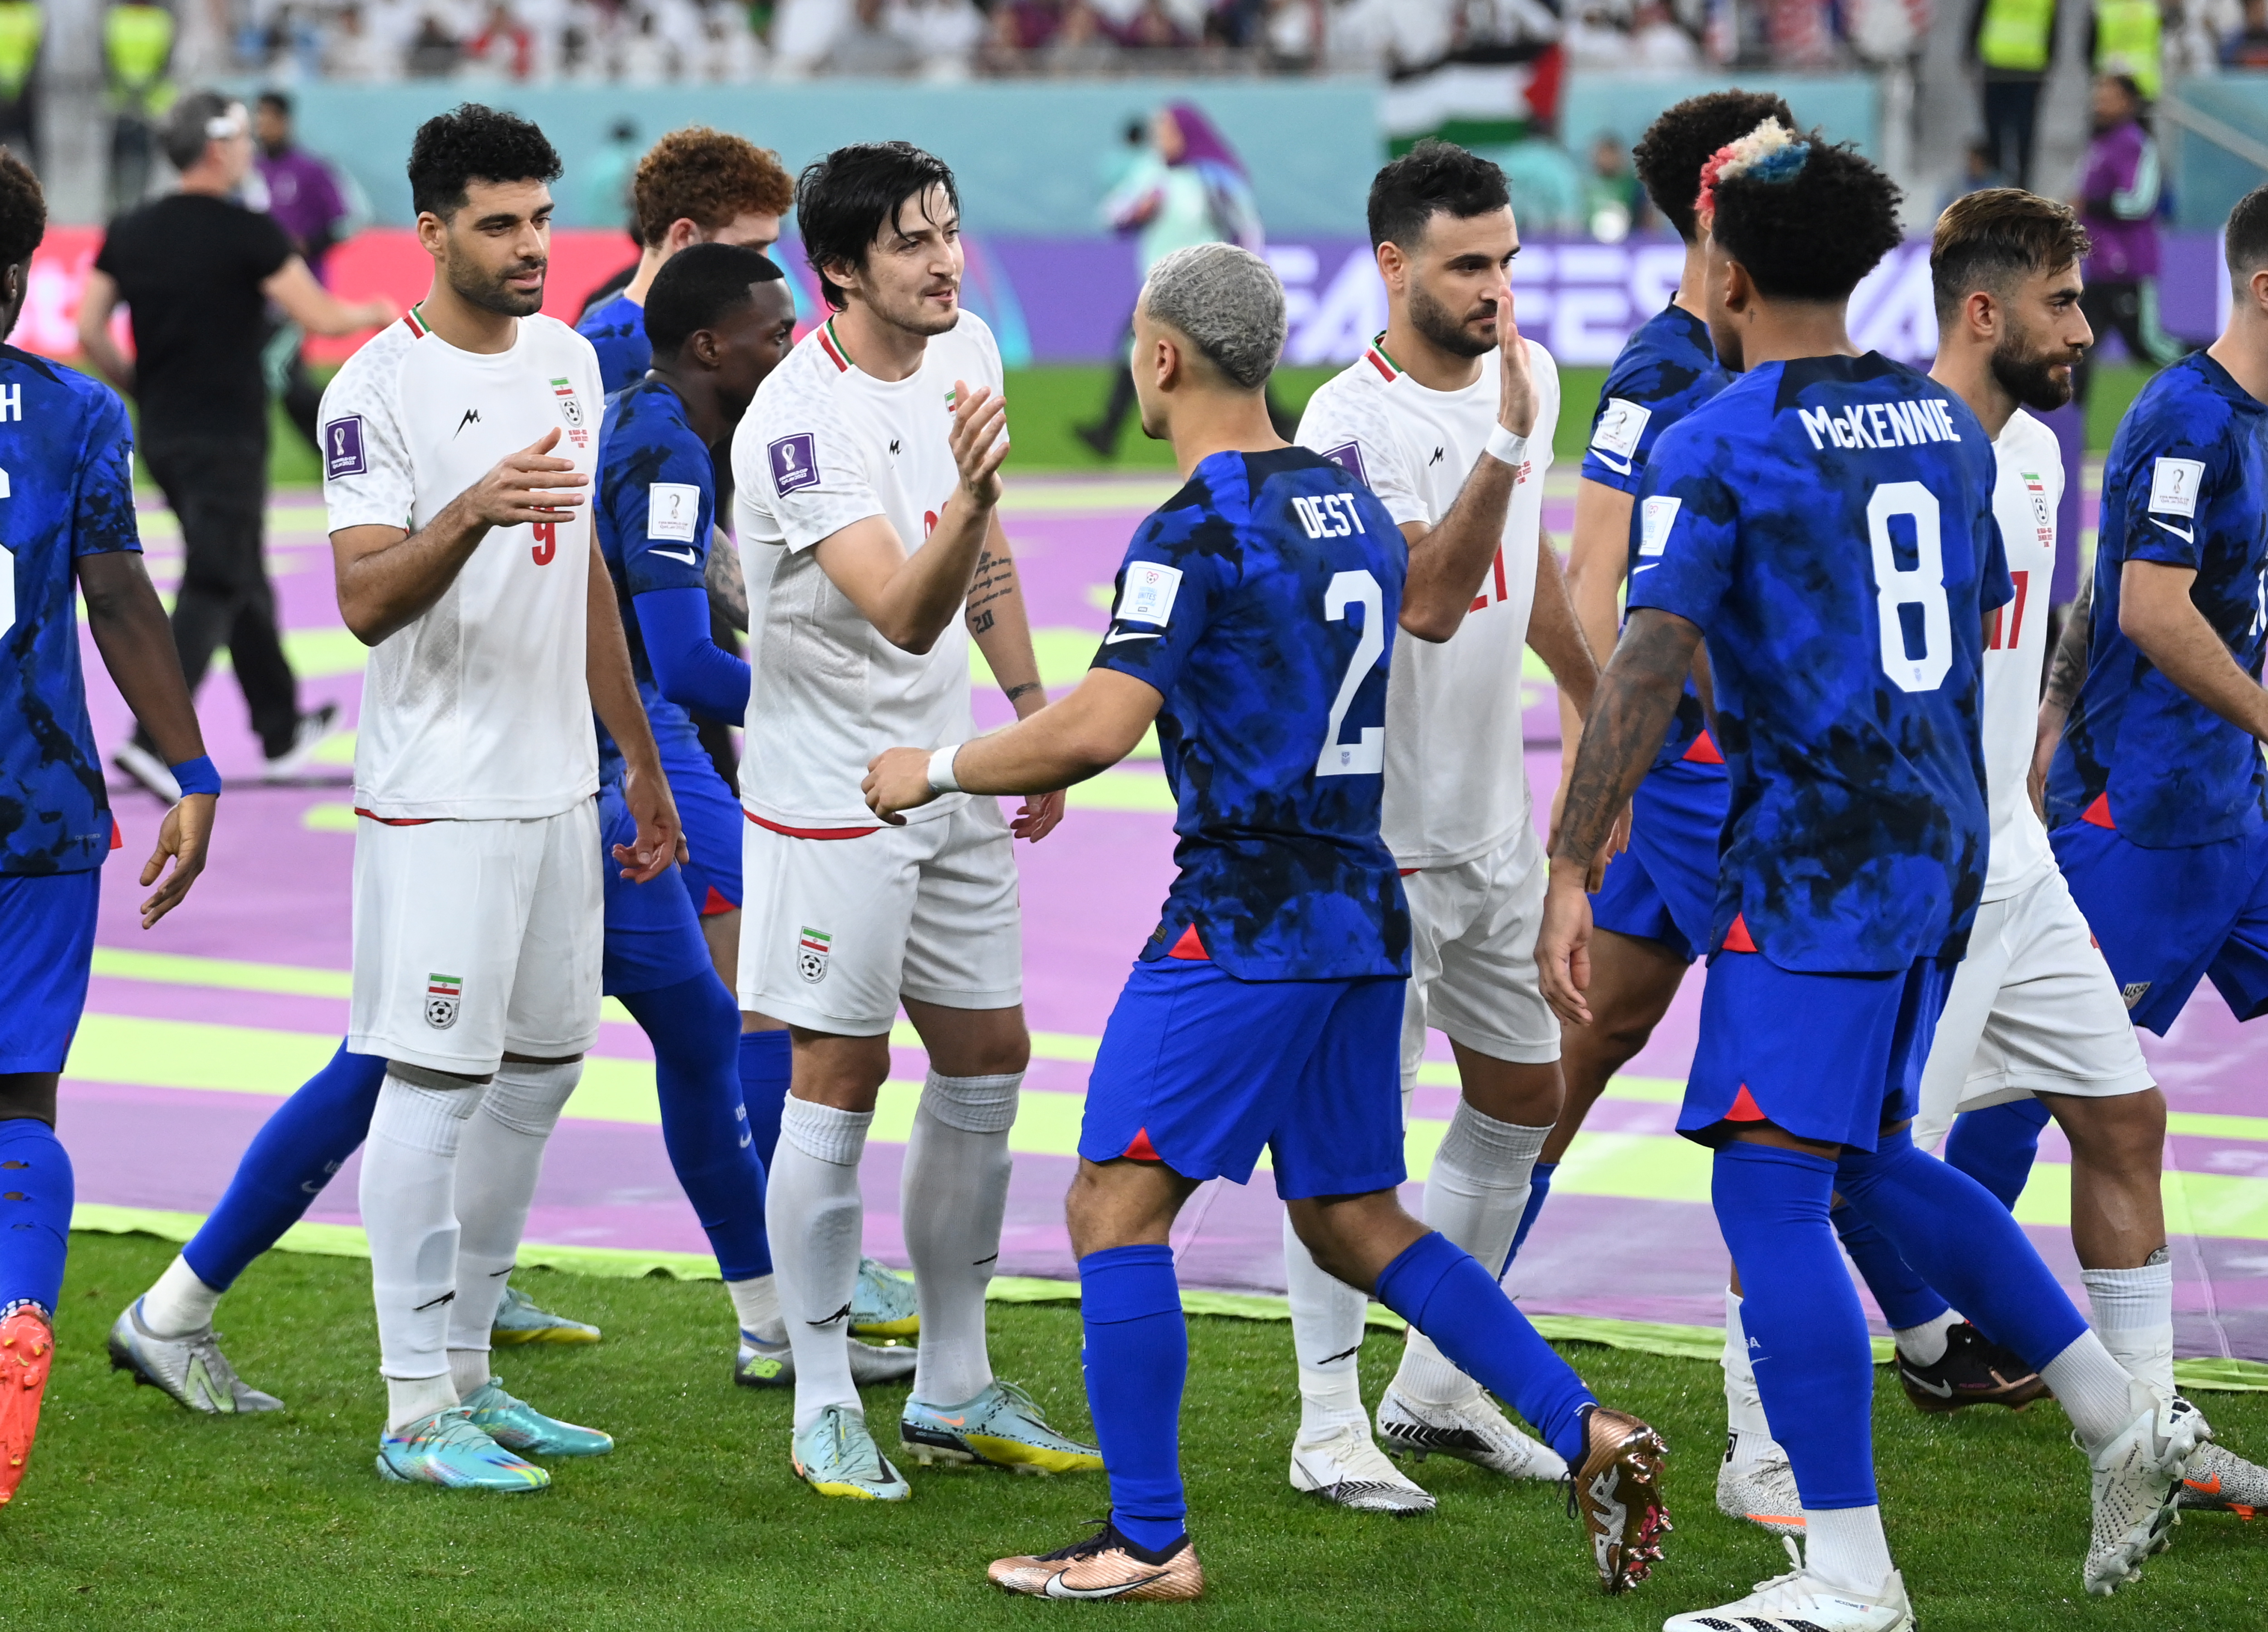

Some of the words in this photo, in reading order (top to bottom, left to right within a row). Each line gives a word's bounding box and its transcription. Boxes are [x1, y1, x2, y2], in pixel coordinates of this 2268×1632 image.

[0, 383, 22, 422] H
[1798, 399, 1961, 450] McKENNIE
[532, 506, 556, 566] 9
[1292, 493, 1365, 539] DEST
[1867, 481, 1952, 692] 8
[1316, 569, 1393, 785] 2
